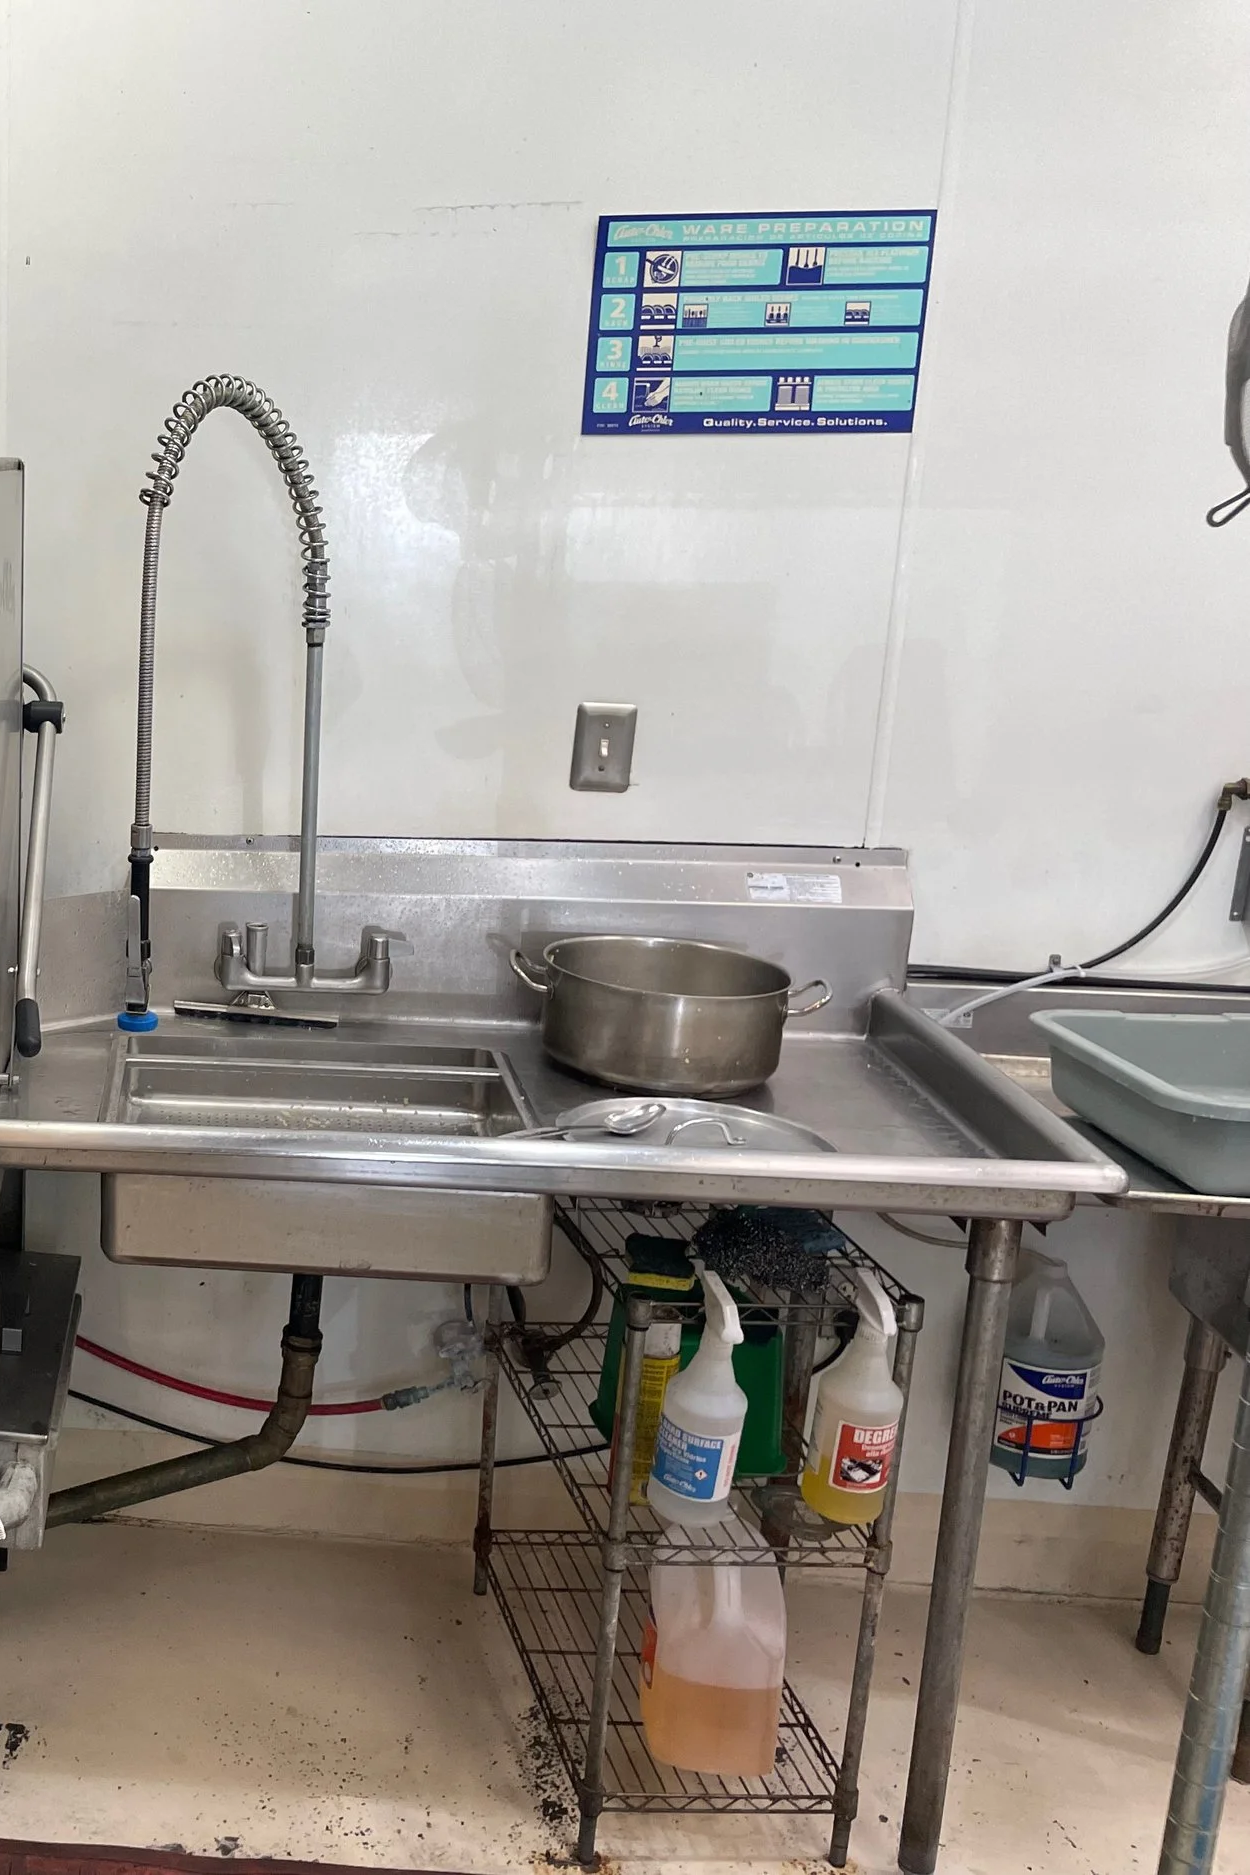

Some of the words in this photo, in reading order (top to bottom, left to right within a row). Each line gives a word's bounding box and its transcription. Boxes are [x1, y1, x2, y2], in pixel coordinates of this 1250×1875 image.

[682, 224, 748, 234] WARE
[758, 220, 924, 233] PREPARATION
[616, 256, 626, 275] 1
[610, 298, 626, 318] 2
[606, 340, 622, 360] 3
[602, 382, 618, 400] 4
[817, 416, 888, 426] Solutions.
[682, 1432, 722, 1449] SURFACE
